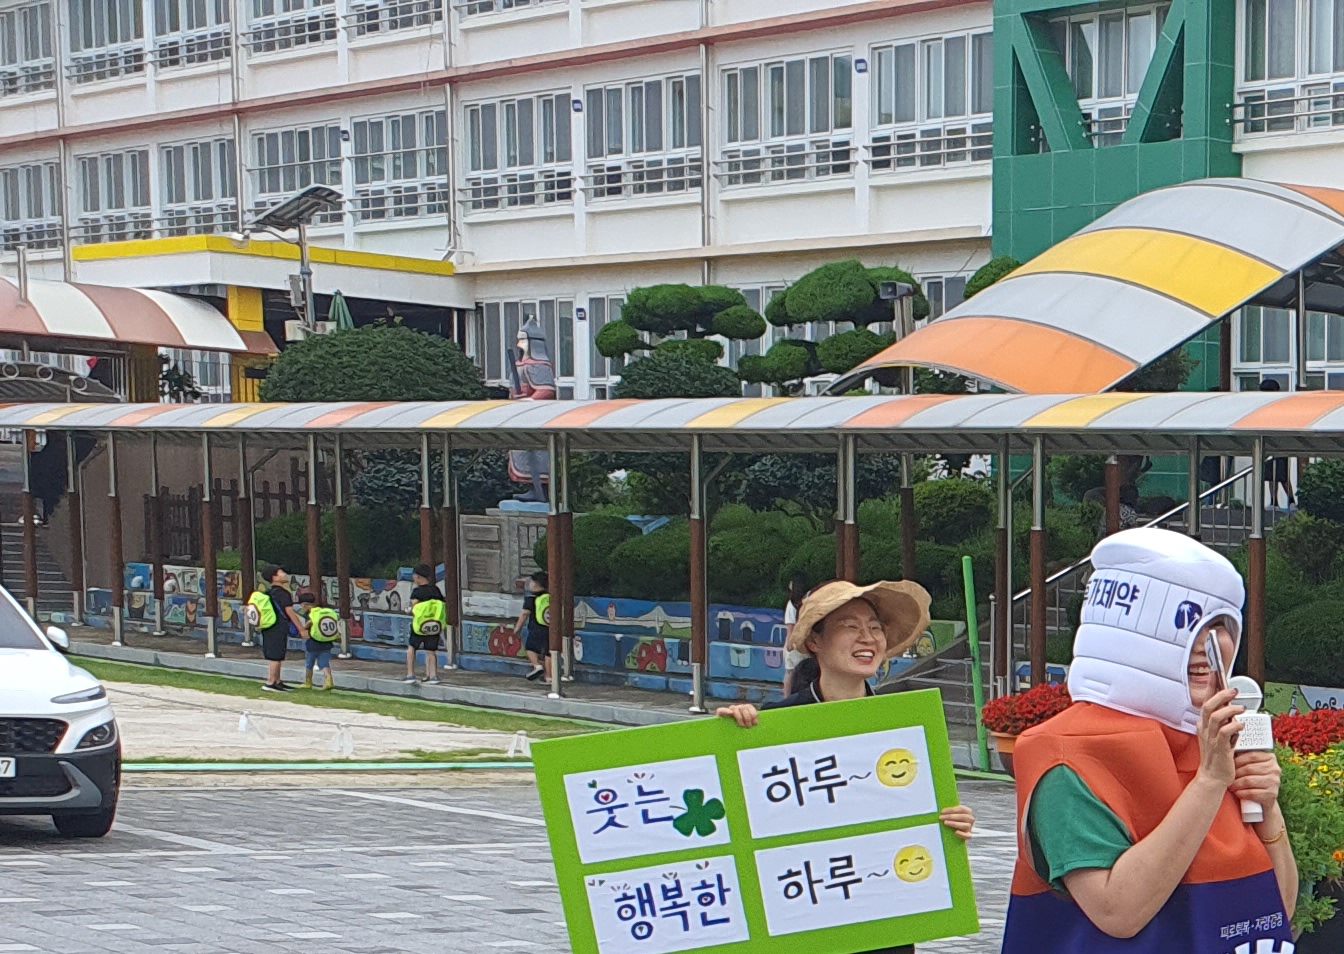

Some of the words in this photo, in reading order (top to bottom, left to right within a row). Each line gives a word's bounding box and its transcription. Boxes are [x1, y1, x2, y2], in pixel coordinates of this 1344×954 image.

[322, 622, 336, 632] 30
[586, 783, 675, 835] 웃는
[614, 872, 732, 941] 행복한
